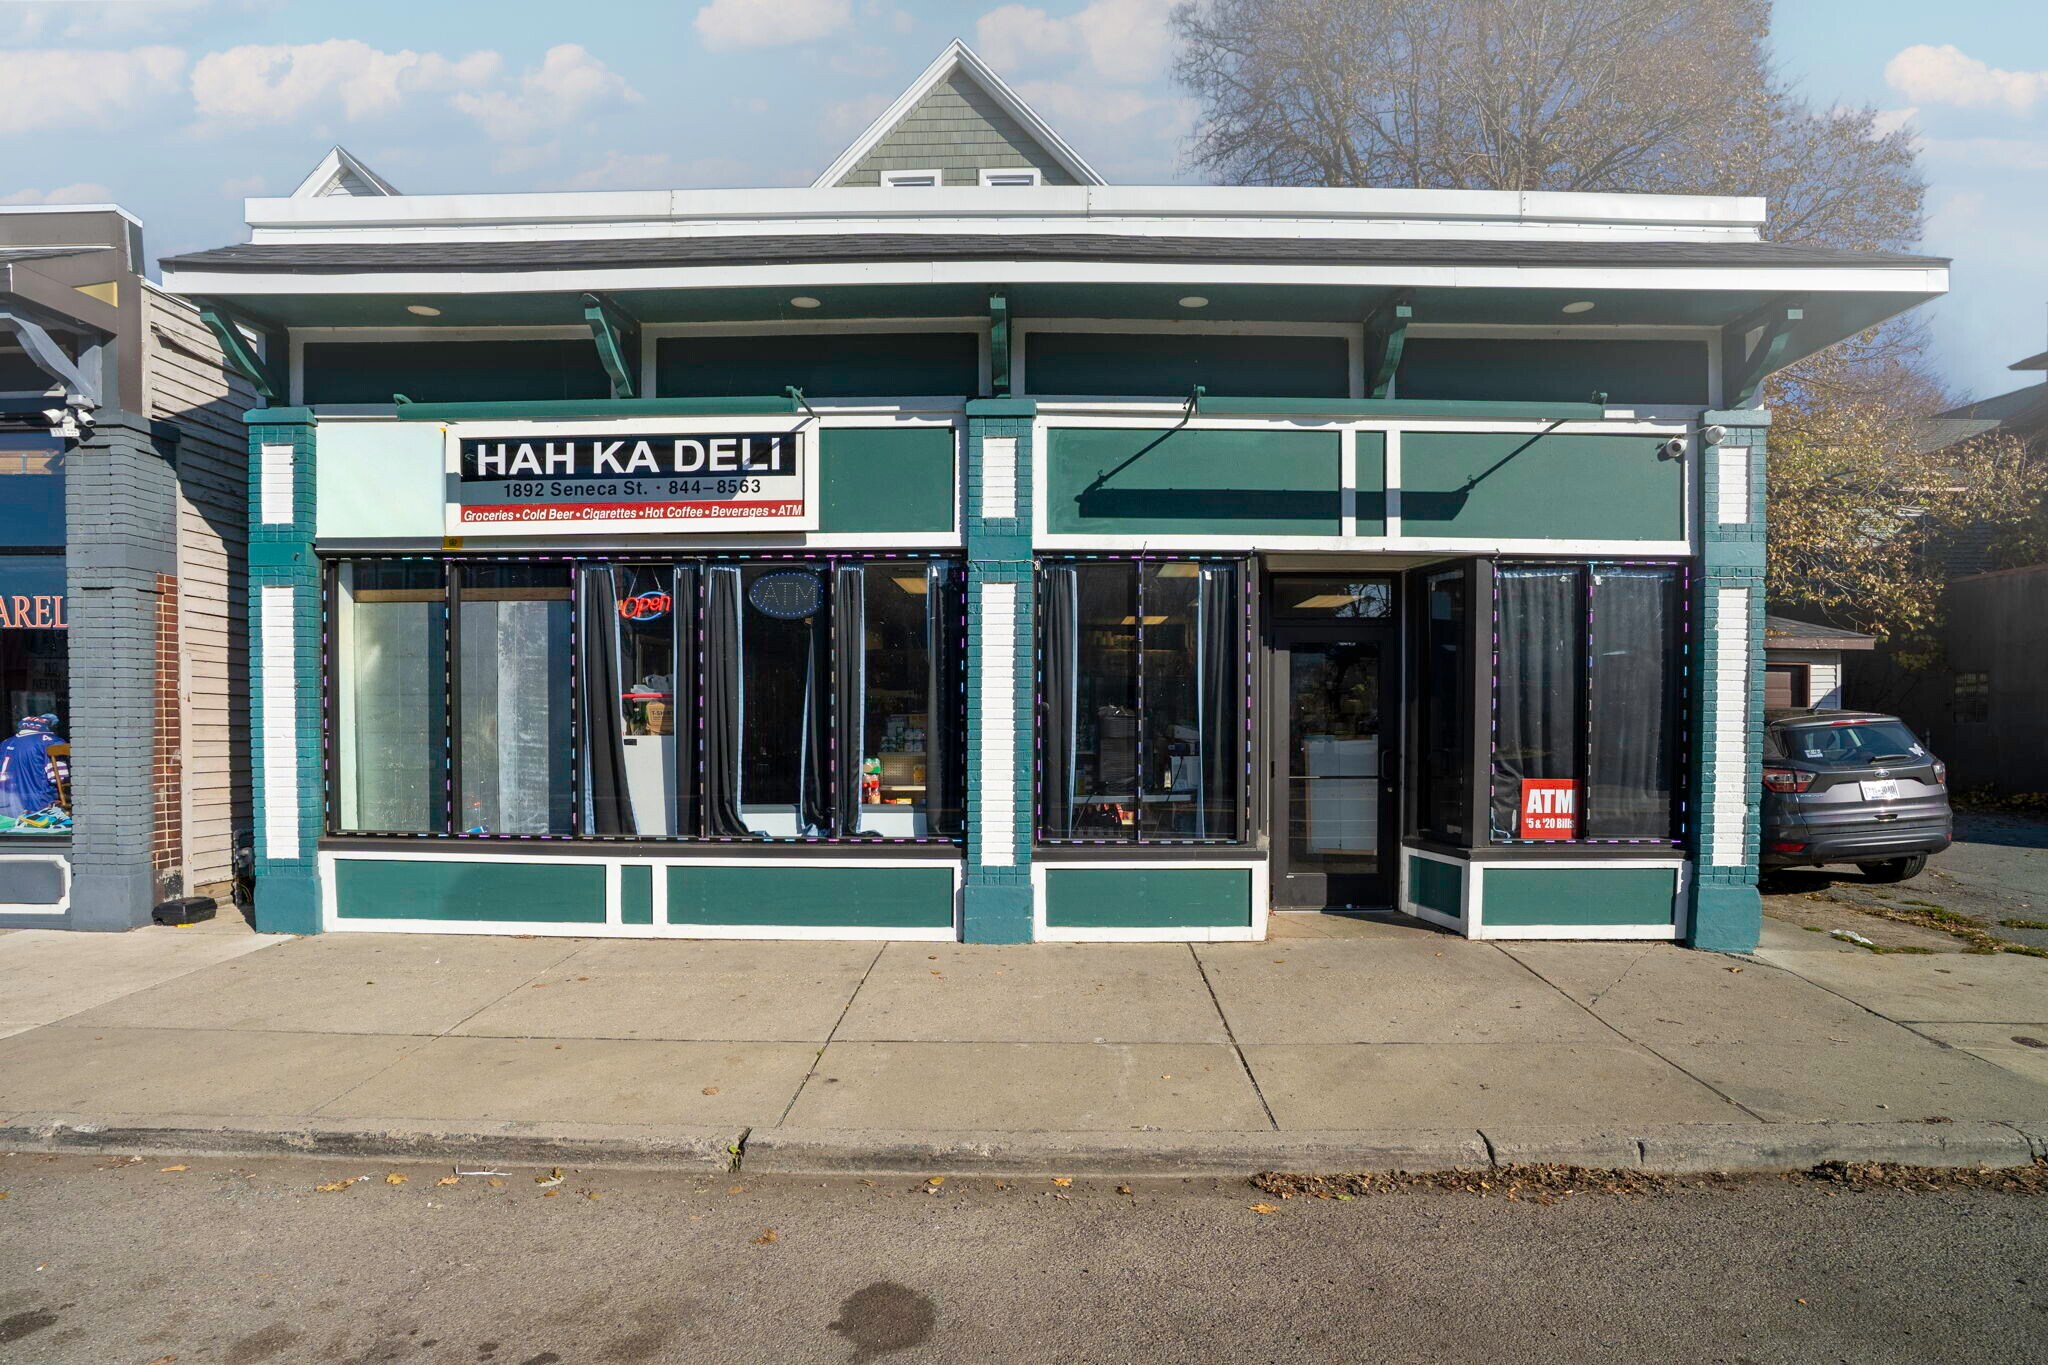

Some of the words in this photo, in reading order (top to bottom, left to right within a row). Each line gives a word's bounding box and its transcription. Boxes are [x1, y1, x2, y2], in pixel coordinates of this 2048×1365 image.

[477, 442, 575, 476] HAH
[593, 440, 661, 474] KA
[674, 437, 780, 472] DELI
[504, 482, 544, 498] 1892
[550, 481, 617, 496] Seneca
[623, 480, 648, 495] St.
[668, 479, 761, 495] 844-8563
[464, 510, 514, 521] Groceries
[522, 509, 546, 520] Cold
[548, 508, 574, 520] Beer
[582, 507, 637, 521] Cigarettes
[645, 507, 663, 518] Hot
[667, 506, 703, 517] Coffee
[711, 505, 769, 518] Beverages
[777, 504, 802, 516] ATM
[761, 581, 817, 606] ATM
[621, 595, 673, 618] Open
[1526, 788, 1576, 814] ATM
[1535, 820, 1541, 829] &
[1556, 818, 1576, 829] Bills
